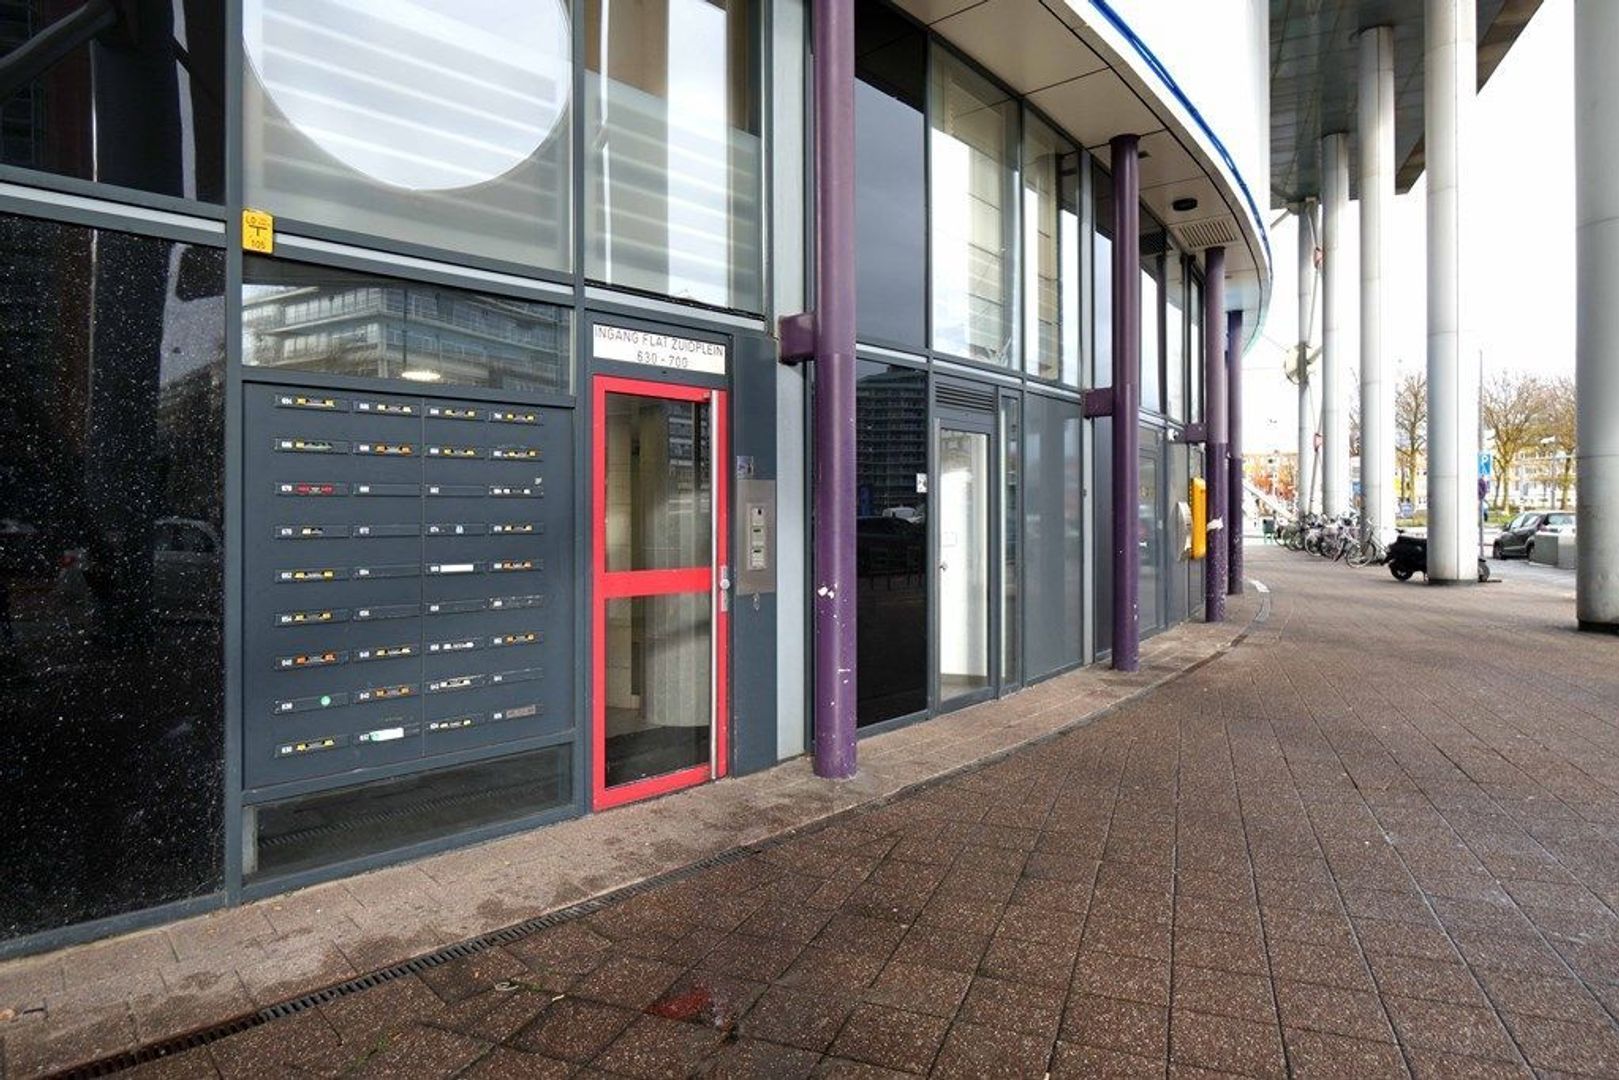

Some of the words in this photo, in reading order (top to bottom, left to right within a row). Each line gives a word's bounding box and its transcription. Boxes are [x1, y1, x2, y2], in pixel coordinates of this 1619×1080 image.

[595, 326, 639, 344] INGANG
[642, 333, 668, 347] FLAT
[671, 338, 724, 356] ZUIDPLEIN
[637, 350, 658, 365] 630
